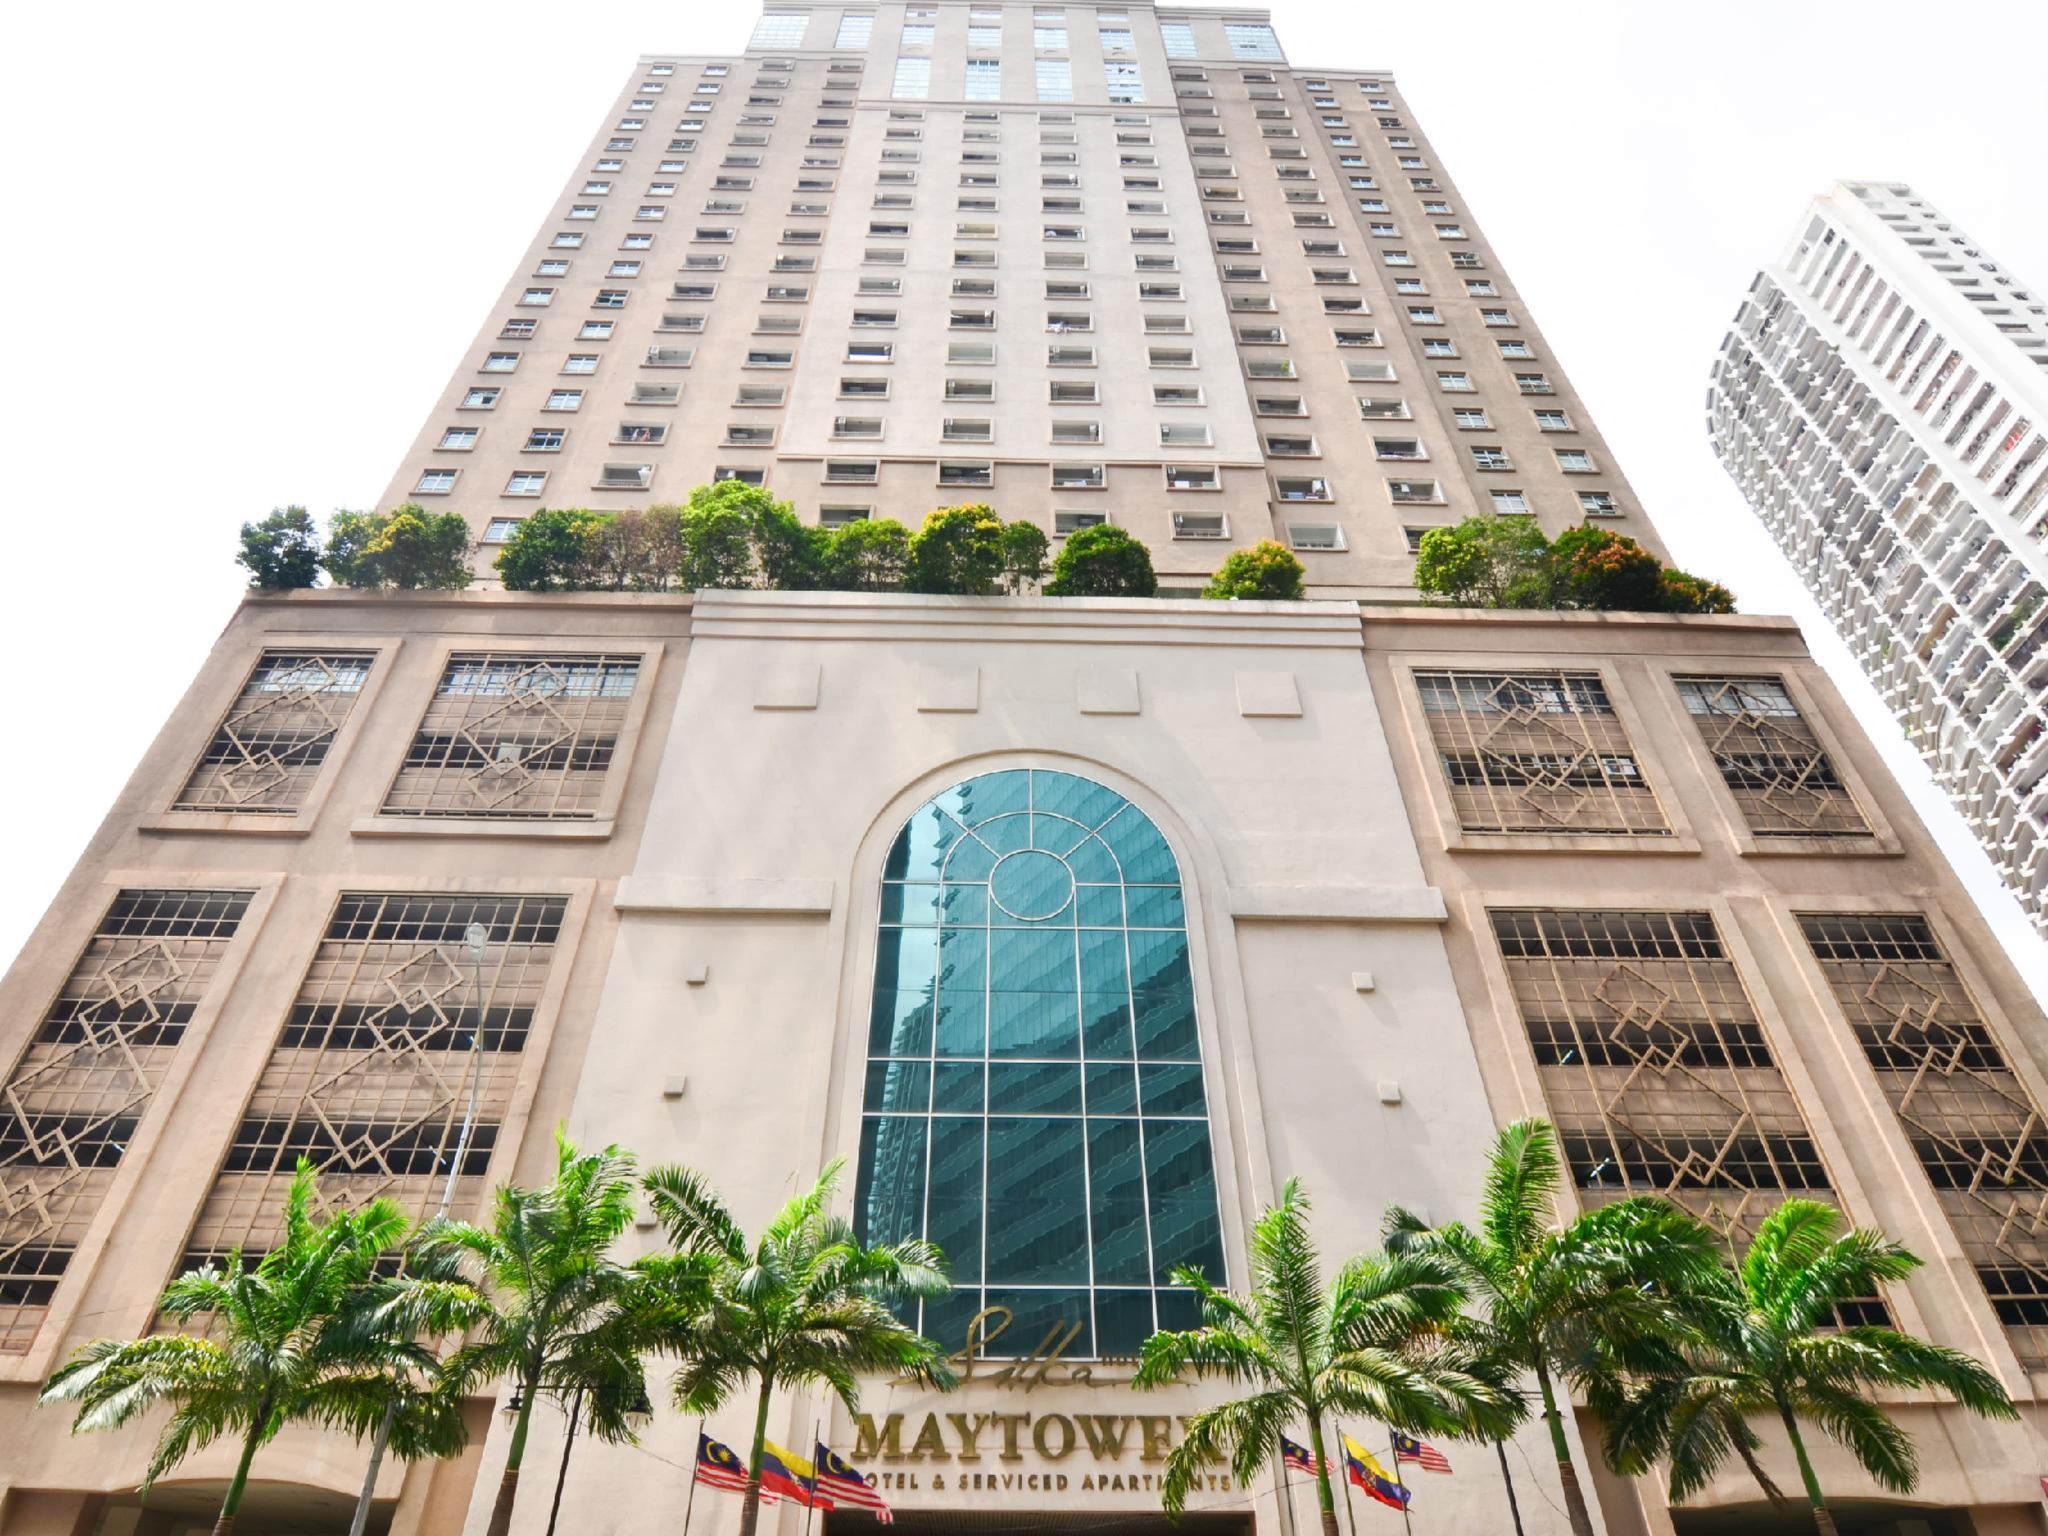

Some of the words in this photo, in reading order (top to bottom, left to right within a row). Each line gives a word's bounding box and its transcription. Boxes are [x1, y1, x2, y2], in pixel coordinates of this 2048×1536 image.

[866, 1472, 919, 1490] OTEL
[932, 1474, 945, 1490] &
[959, 1474, 1068, 1491] SERVICED
[1082, 1474, 1231, 1491] APARTNTS
